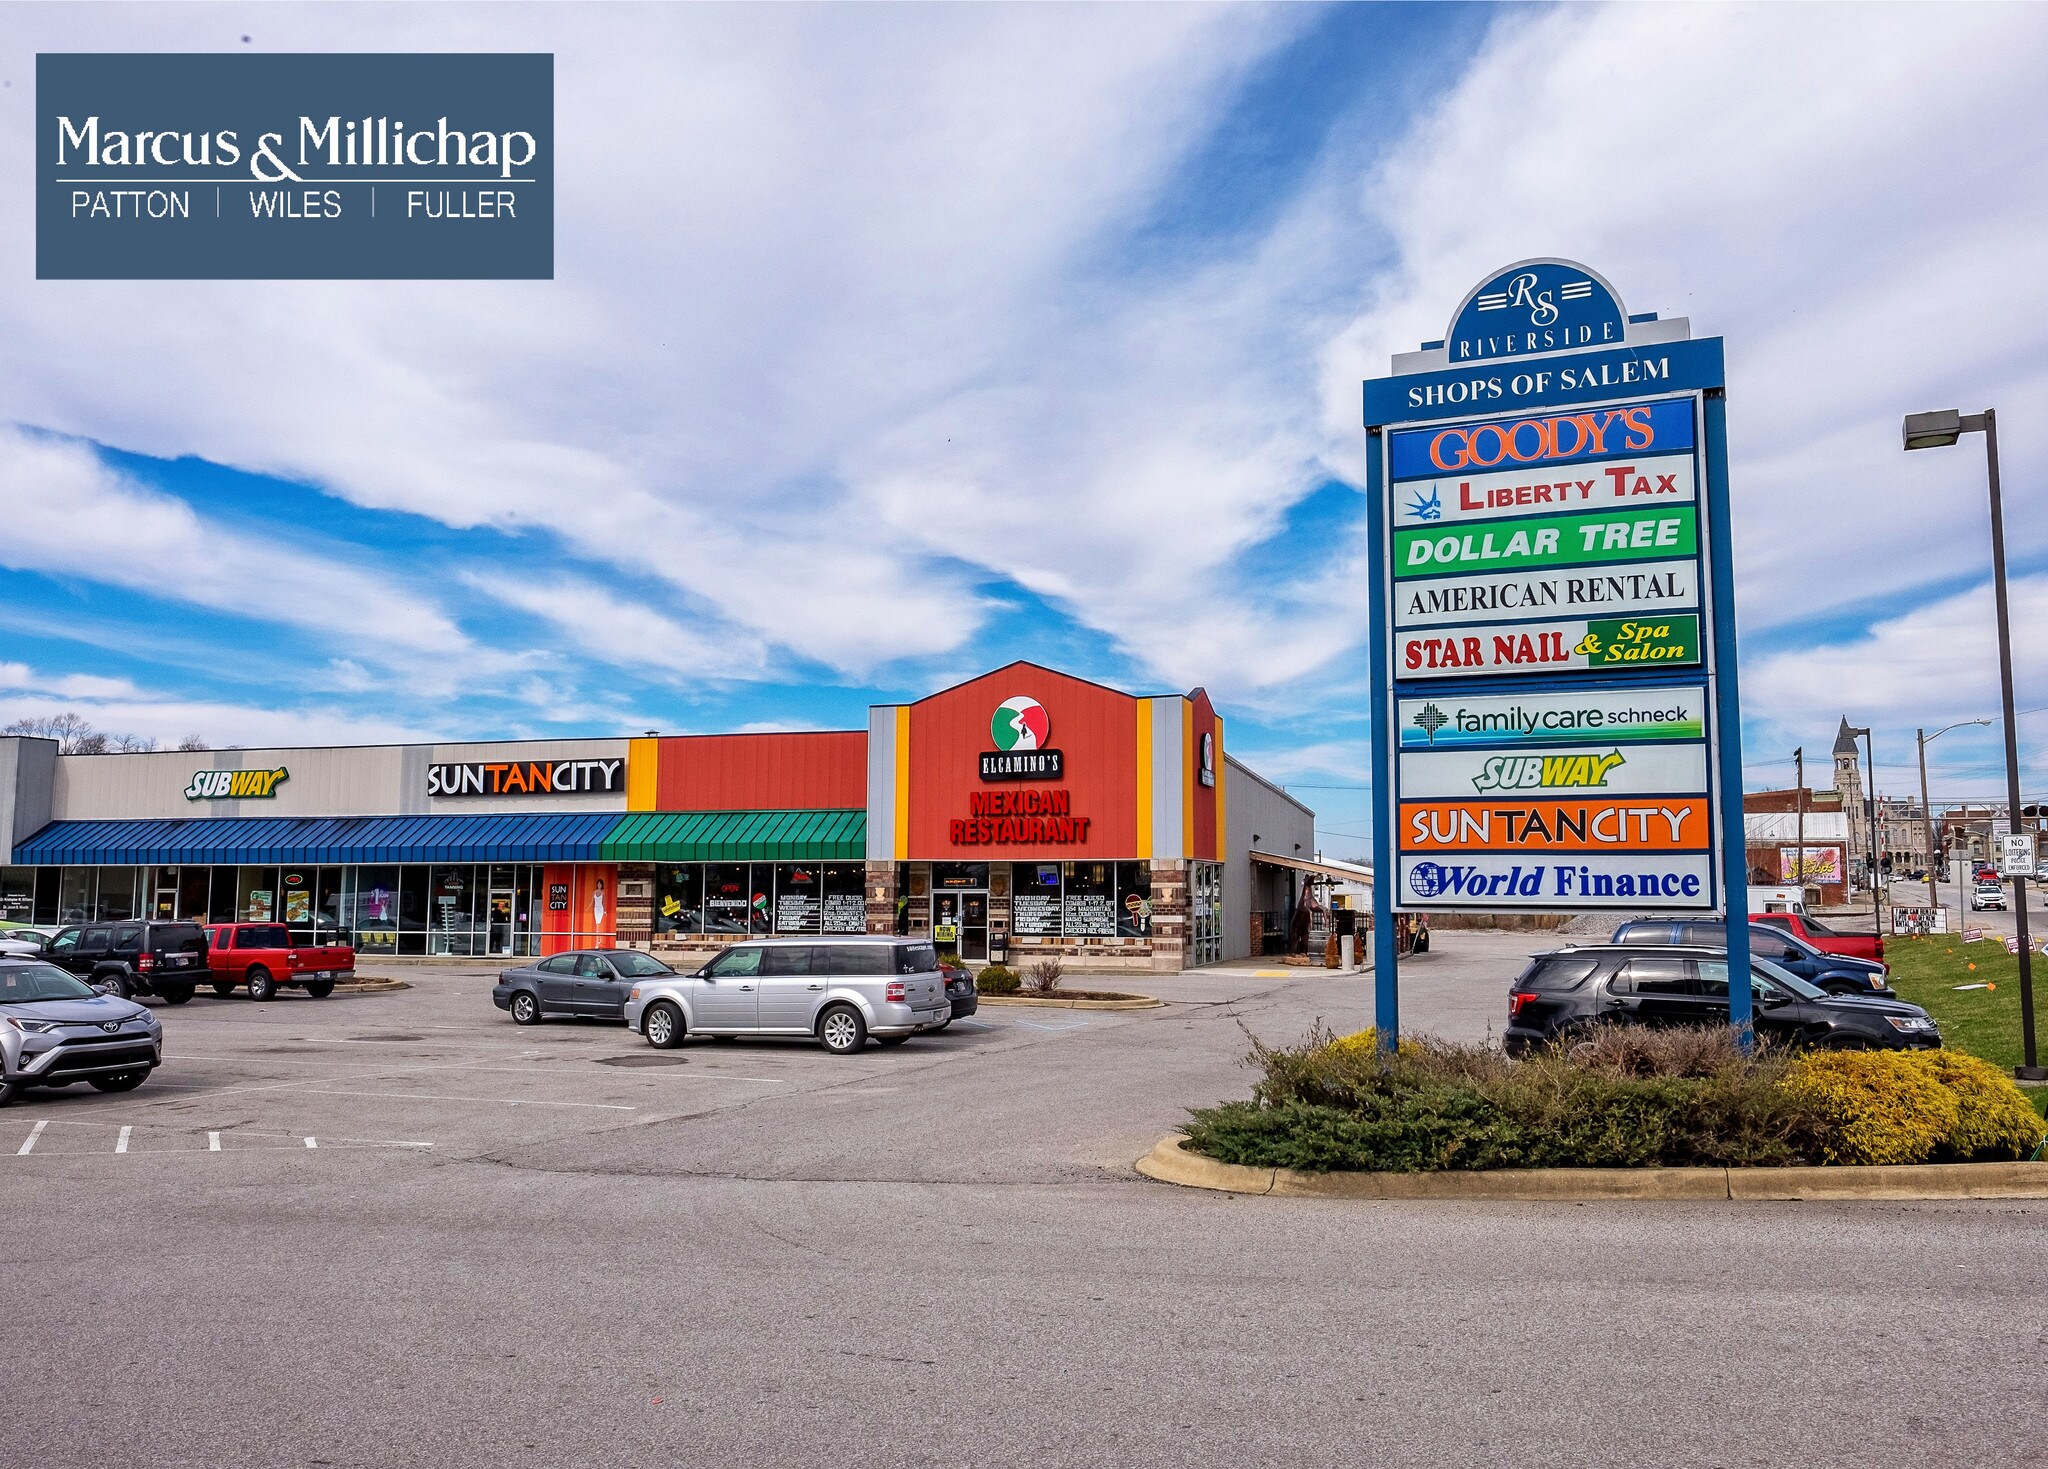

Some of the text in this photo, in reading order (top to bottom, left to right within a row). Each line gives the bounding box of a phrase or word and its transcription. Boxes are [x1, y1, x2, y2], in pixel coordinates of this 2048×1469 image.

[1460, 321, 1614, 358] RIVERSIDE
[1408, 357, 1670, 408] SHOPS OF SALEM
[1429, 406, 1654, 471] GOODY'S
[1460, 466, 1677, 511] LIBERTY TAX
[1407, 518, 1681, 566] DOLLAR TREE
[1408, 572, 1685, 615] AMERICAN RENTAL
[1617, 622, 1669, 643] Spa
[1405, 632, 1603, 670] STAR NAIL &
[1604, 643, 1684, 662] Salon
[1608, 706, 1688, 724] schneck
[184, 766, 290, 801] SUBWAY
[1472, 748, 1626, 794] SUBWAY
[970, 790, 1069, 817] MEXICAN
[950, 818, 1090, 844] RESTAURANT
[1438, 866, 1700, 896] World Finance
[550, 902, 567, 910] CITY
